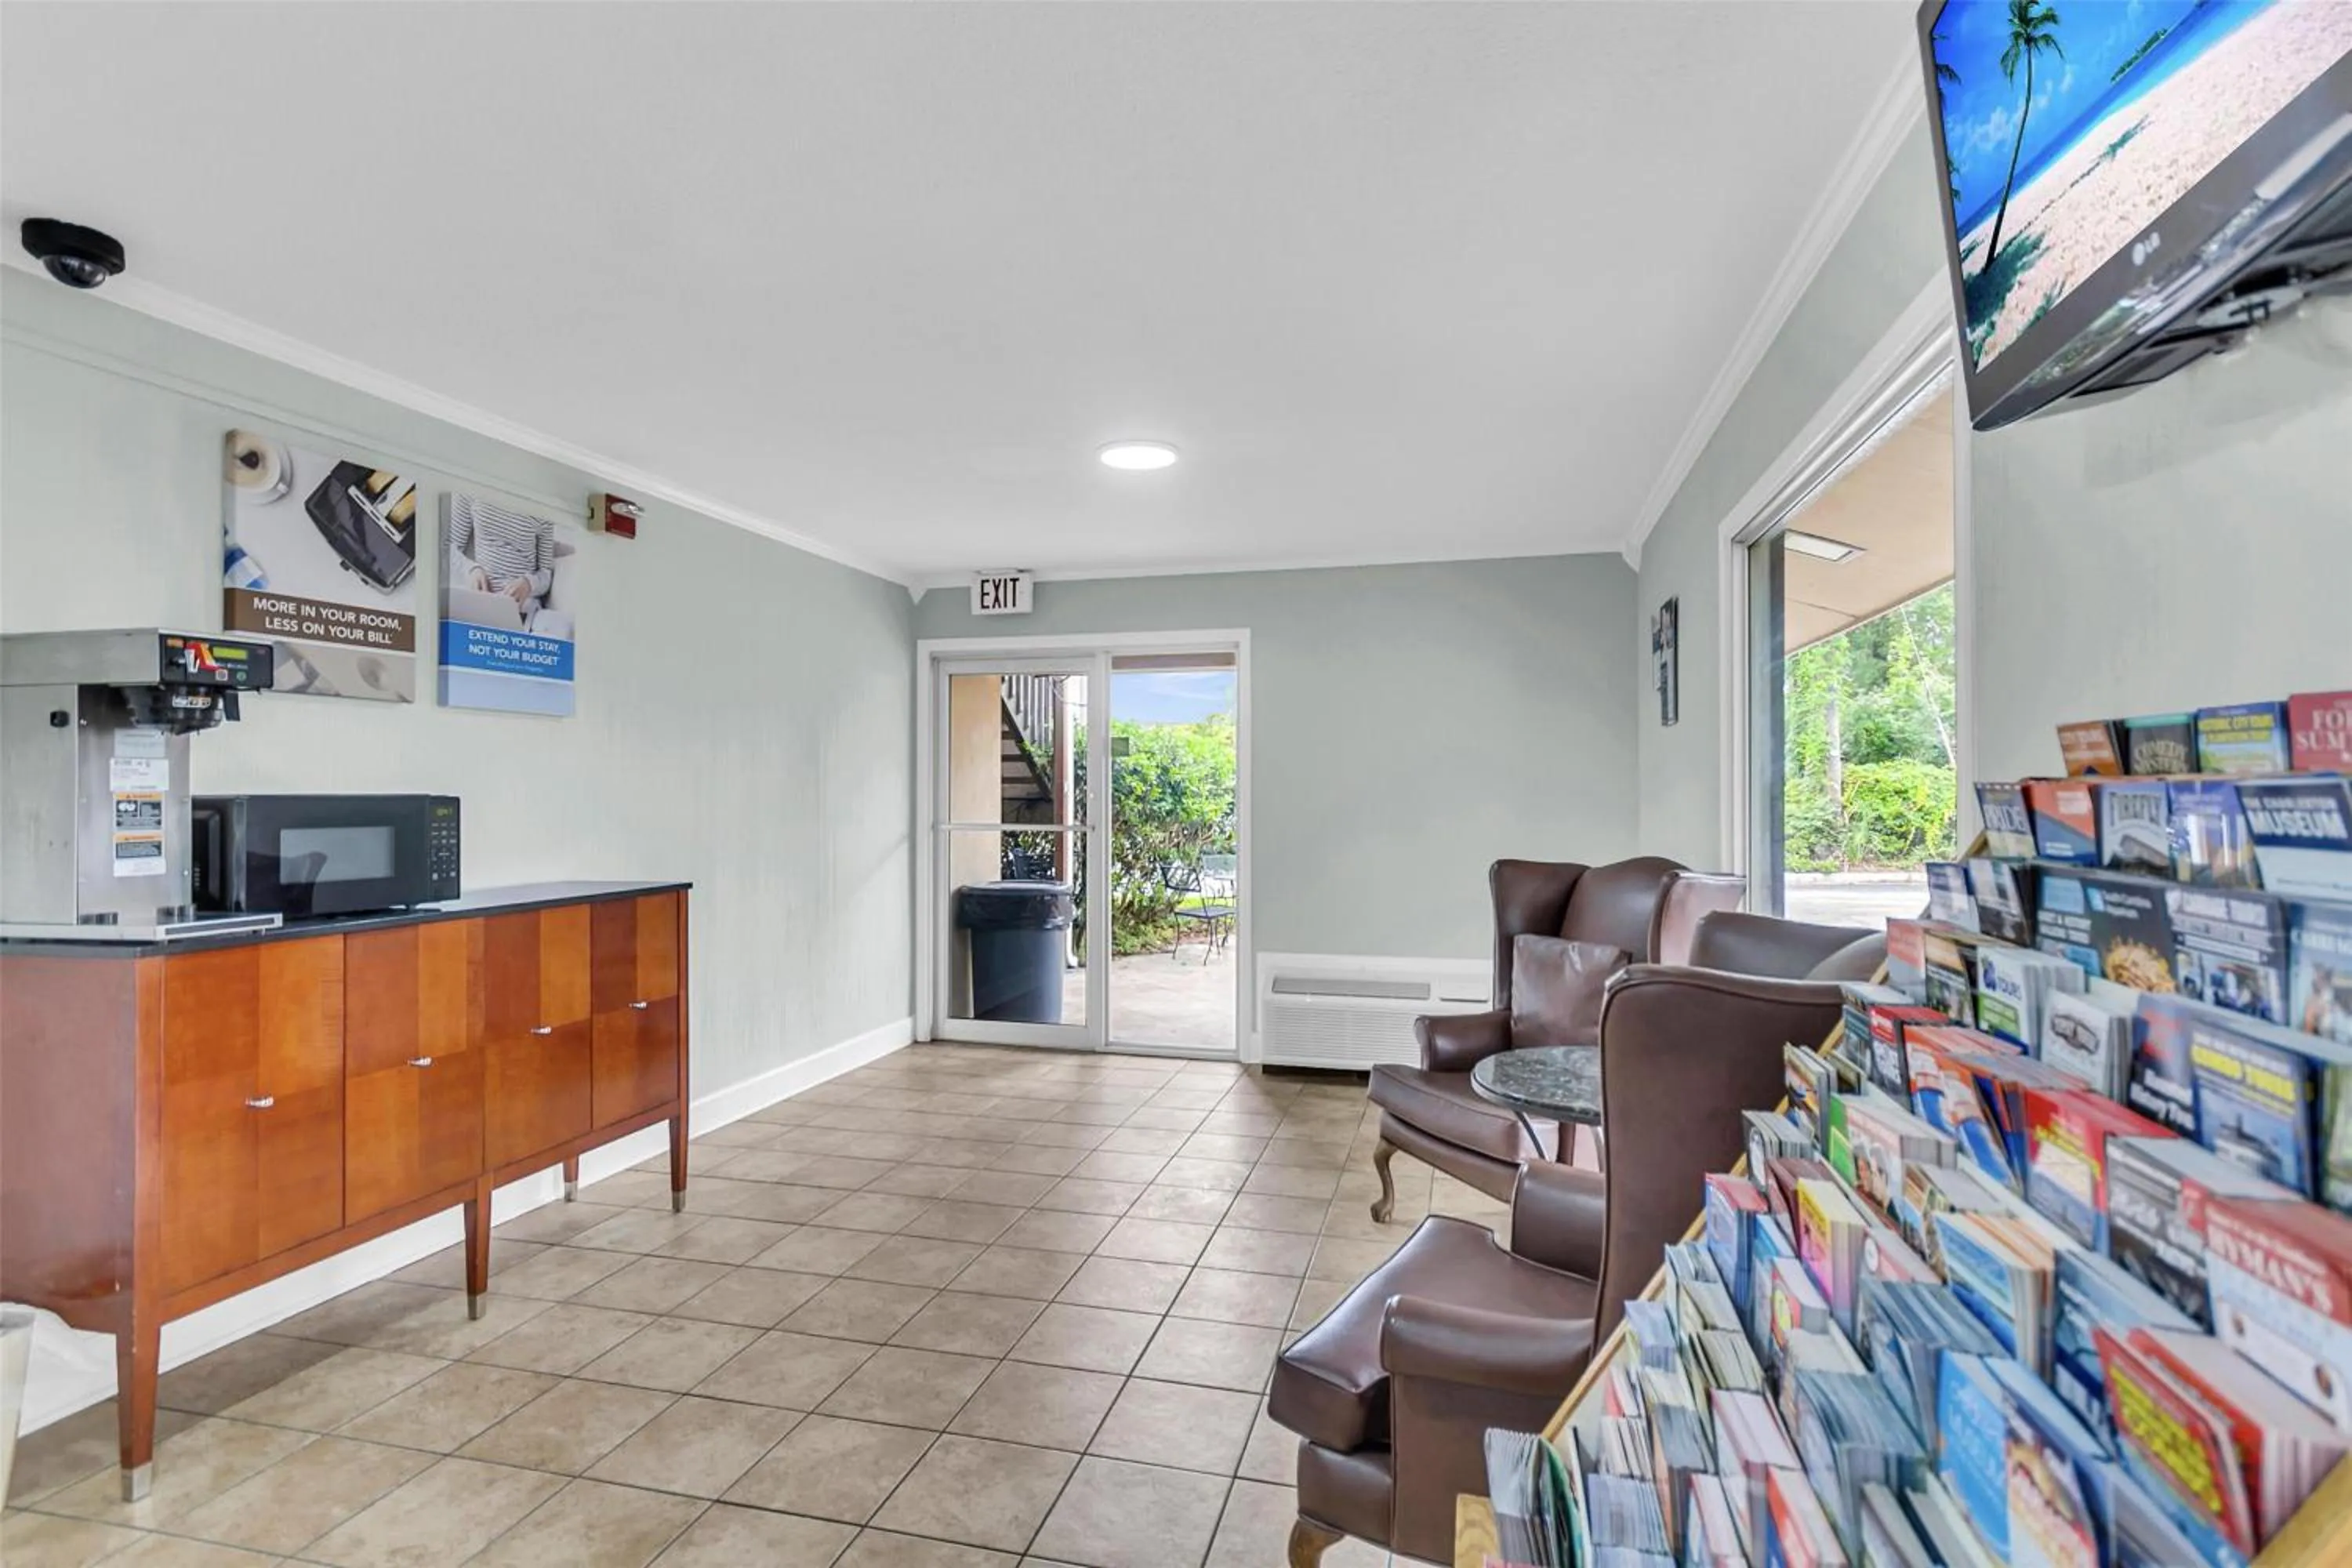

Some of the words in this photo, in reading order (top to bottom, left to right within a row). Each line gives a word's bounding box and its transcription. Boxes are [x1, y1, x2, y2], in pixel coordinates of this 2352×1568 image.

[981, 577, 1020, 609] EXIT
[253, 597, 297, 615] MORE
[300, 604, 316, 618] IN
[319, 607, 356, 624] YOUR
[359, 614, 402, 633] ROOM,
[265, 616, 299, 633] LESS
[302, 621, 325, 636] ON
[328, 625, 365, 641] YOUR
[468, 630, 508, 644] EXTEND
[510, 637, 536, 649] YOUR
[539, 641, 561, 654] STAY,
[468, 644, 491, 656] NOT
[493, 648, 520, 661] YOUR
[521, 652, 559, 666] BUDGET
[2247, 810, 2348, 839] MUSEUM
